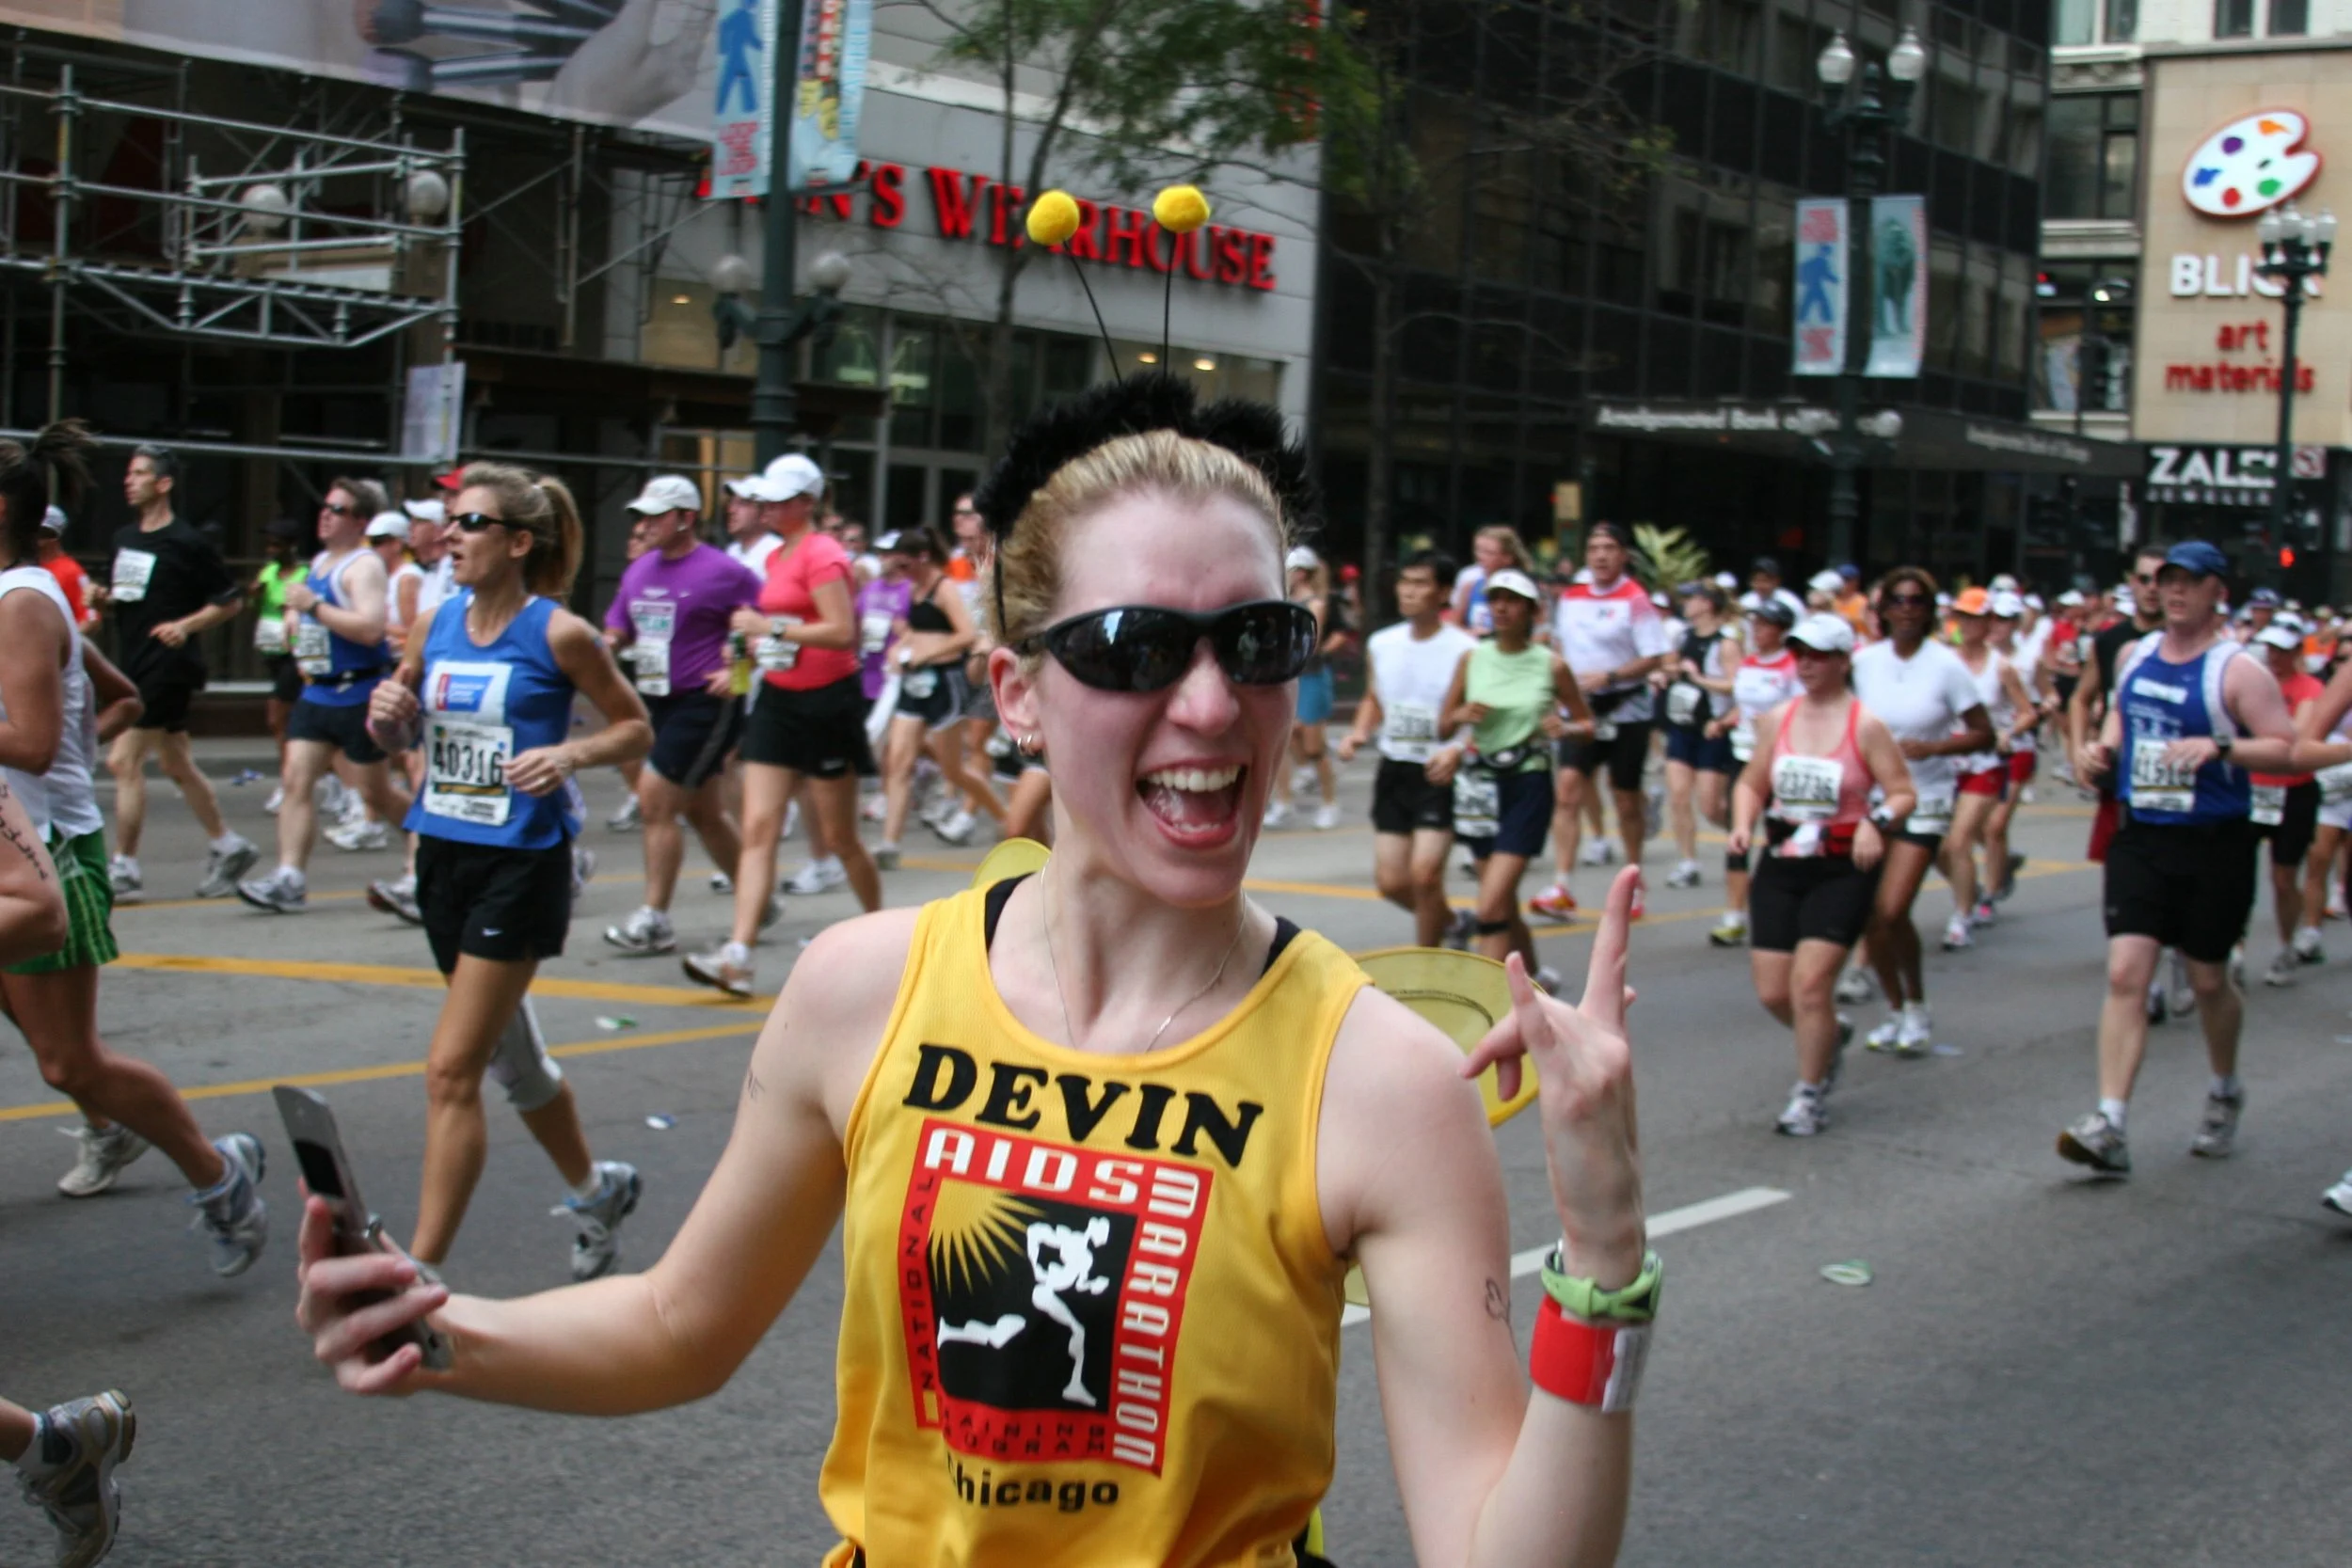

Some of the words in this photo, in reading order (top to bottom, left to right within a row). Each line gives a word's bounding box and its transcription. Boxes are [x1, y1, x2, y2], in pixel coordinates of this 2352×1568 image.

[926, 166, 1277, 291] WERHOUSE
[2217, 319, 2268, 351] art
[433, 740, 503, 786] 40316
[902, 1043, 1263, 1169] DEVIN
[924, 1129, 1144, 1205] AIDS
[906, 1175, 934, 1390] NATIONAL
[1112, 1165, 1200, 1465] MARATHON
